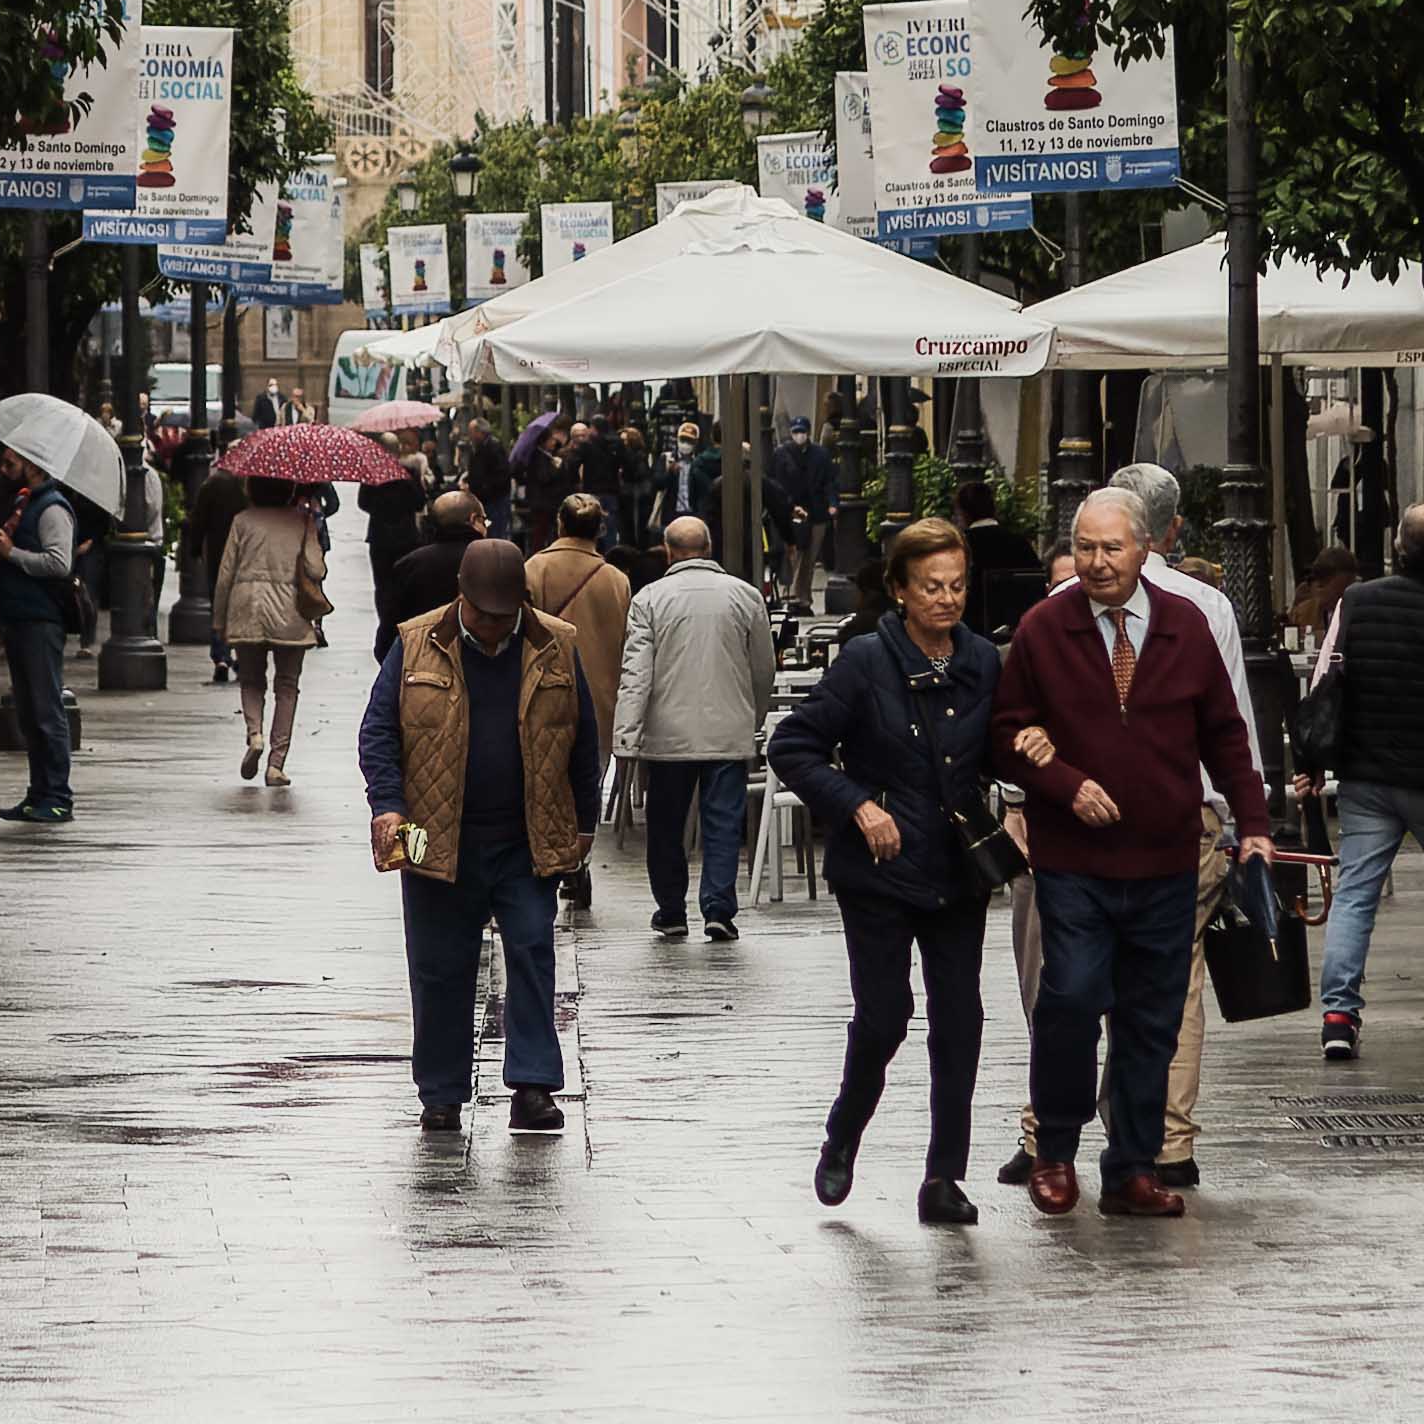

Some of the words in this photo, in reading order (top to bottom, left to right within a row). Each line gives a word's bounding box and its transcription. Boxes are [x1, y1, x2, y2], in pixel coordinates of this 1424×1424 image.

[160, 80, 224, 100] SOCIAL
[986, 119, 1045, 133] Claustros
[1049, 117, 1064, 131] de
[1068, 116, 1104, 130] Santo
[1109, 113, 1165, 128] Domingo
[38, 140, 71, 153] Santo
[76, 142, 126, 156] Domingo
[1000, 139, 1017, 153] 11,
[1022, 138, 1035, 151] 12
[1038, 140, 1046, 153] y
[1051, 137, 1064, 150] 13
[1068, 135, 1083, 149] de
[1087, 133, 1153, 147] noviembre
[10, 160, 16, 171] y
[21, 157, 33, 169] 13
[36, 158, 50, 170] de
[53, 158, 114, 171] noviembre
[986, 158, 1098, 187] ¡VISÍTANOS!
[885, 178, 931, 192] Claustros
[933, 178, 945, 189] de
[947, 176, 976, 187] Santo
[179, 193, 220, 205] Domingo
[913, 195, 922, 205] 12
[926, 197, 931, 206] y
[935, 193, 944, 203] 13
[947, 192, 959, 202] de
[915, 336, 1028, 357] Cruzcampo
[937, 360, 1000, 373] ESPECIAL
